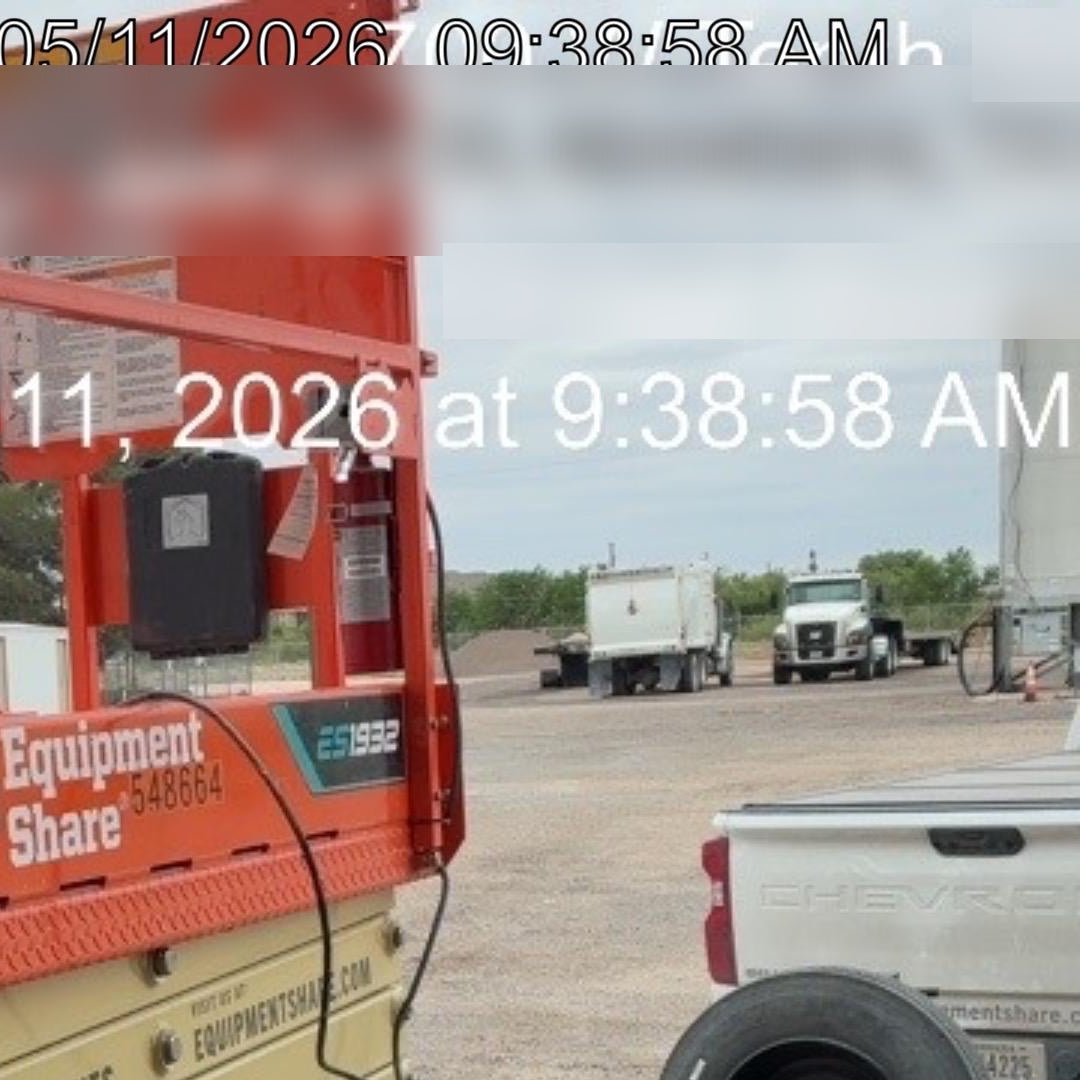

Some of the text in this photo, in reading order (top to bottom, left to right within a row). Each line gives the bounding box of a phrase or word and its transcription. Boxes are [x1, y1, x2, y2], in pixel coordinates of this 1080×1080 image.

[0, 711, 205, 799] Equipment
[317, 719, 400, 760] ES1932
[130, 763, 223, 815] 548664
[8, 803, 122, 868] Share
[760, 883, 1080, 915] CHEVRO
